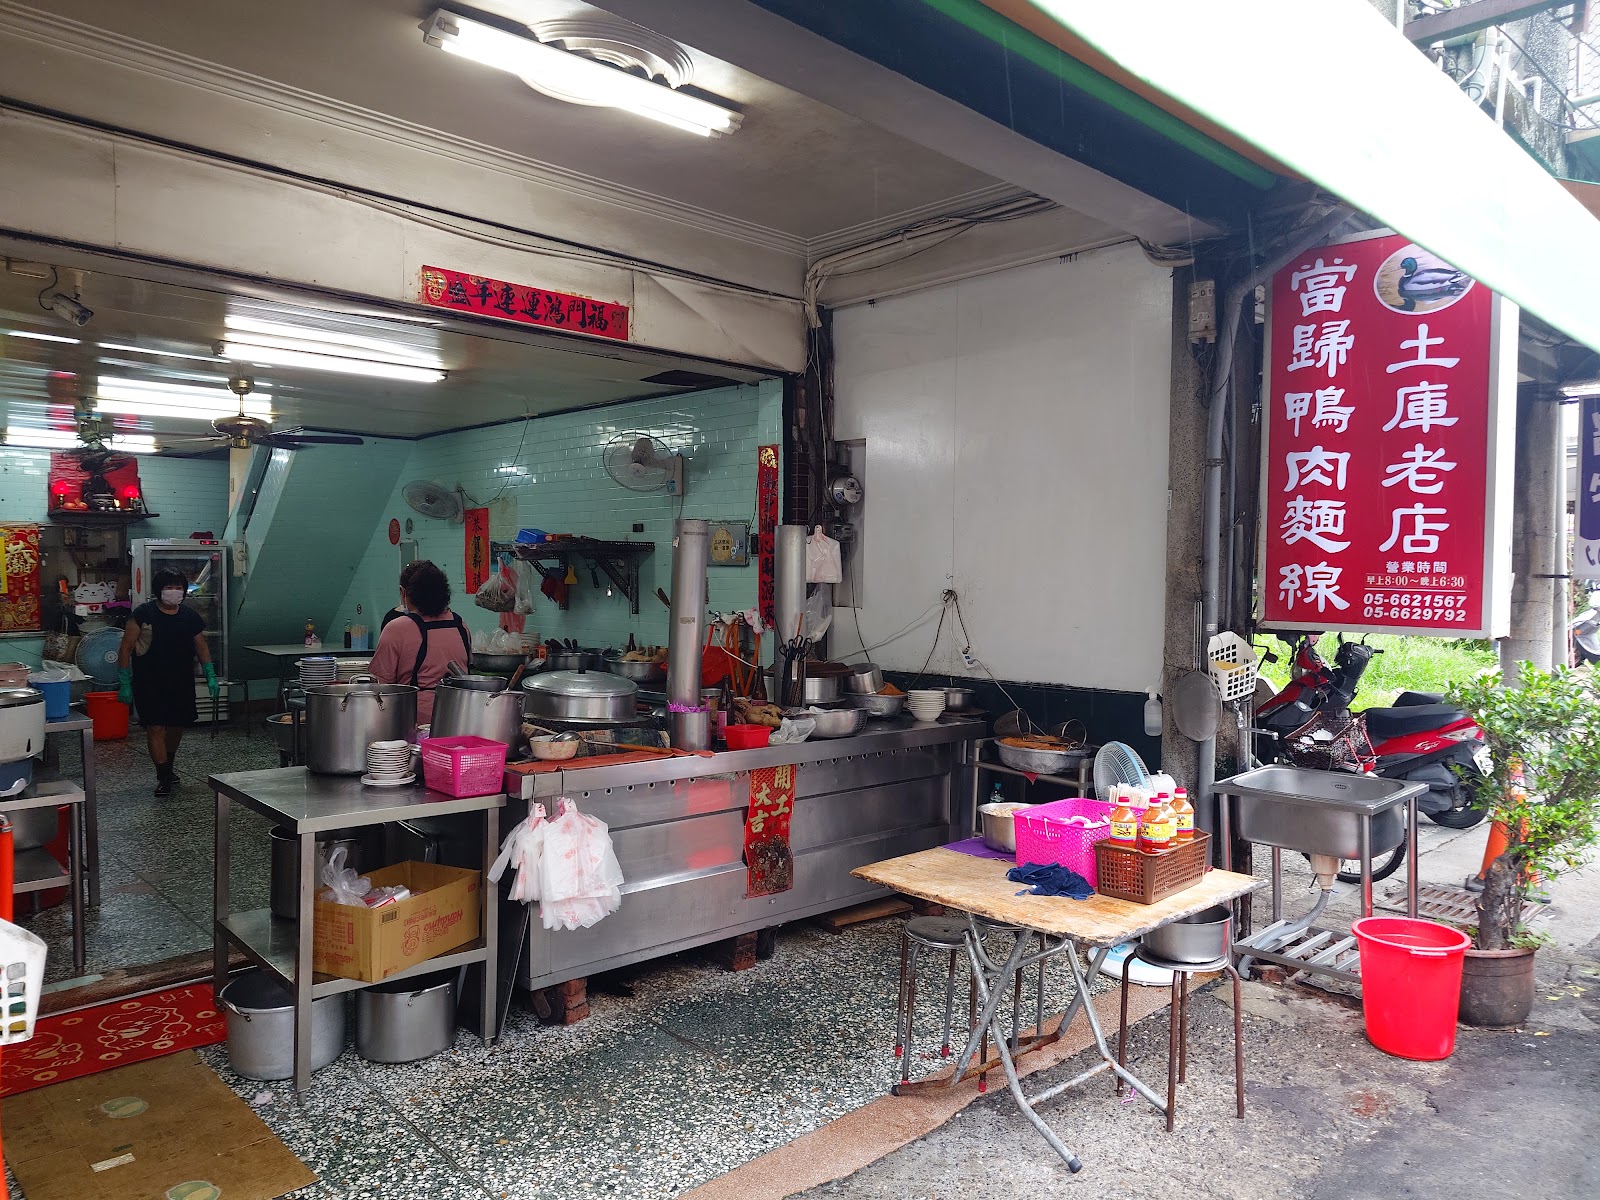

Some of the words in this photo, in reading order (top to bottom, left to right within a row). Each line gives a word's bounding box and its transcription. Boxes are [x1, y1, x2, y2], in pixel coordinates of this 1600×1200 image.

[1278, 258, 1358, 613] 當歸鴨肉麵線
[1379, 323, 1460, 555] 土庫老店
[1385, 561, 1448, 574] 營業時間
[1363, 593, 1467, 608] 05-6621567
[1363, 606, 1467, 622] 05-6629792
[749, 782, 773, 834] 大吉
